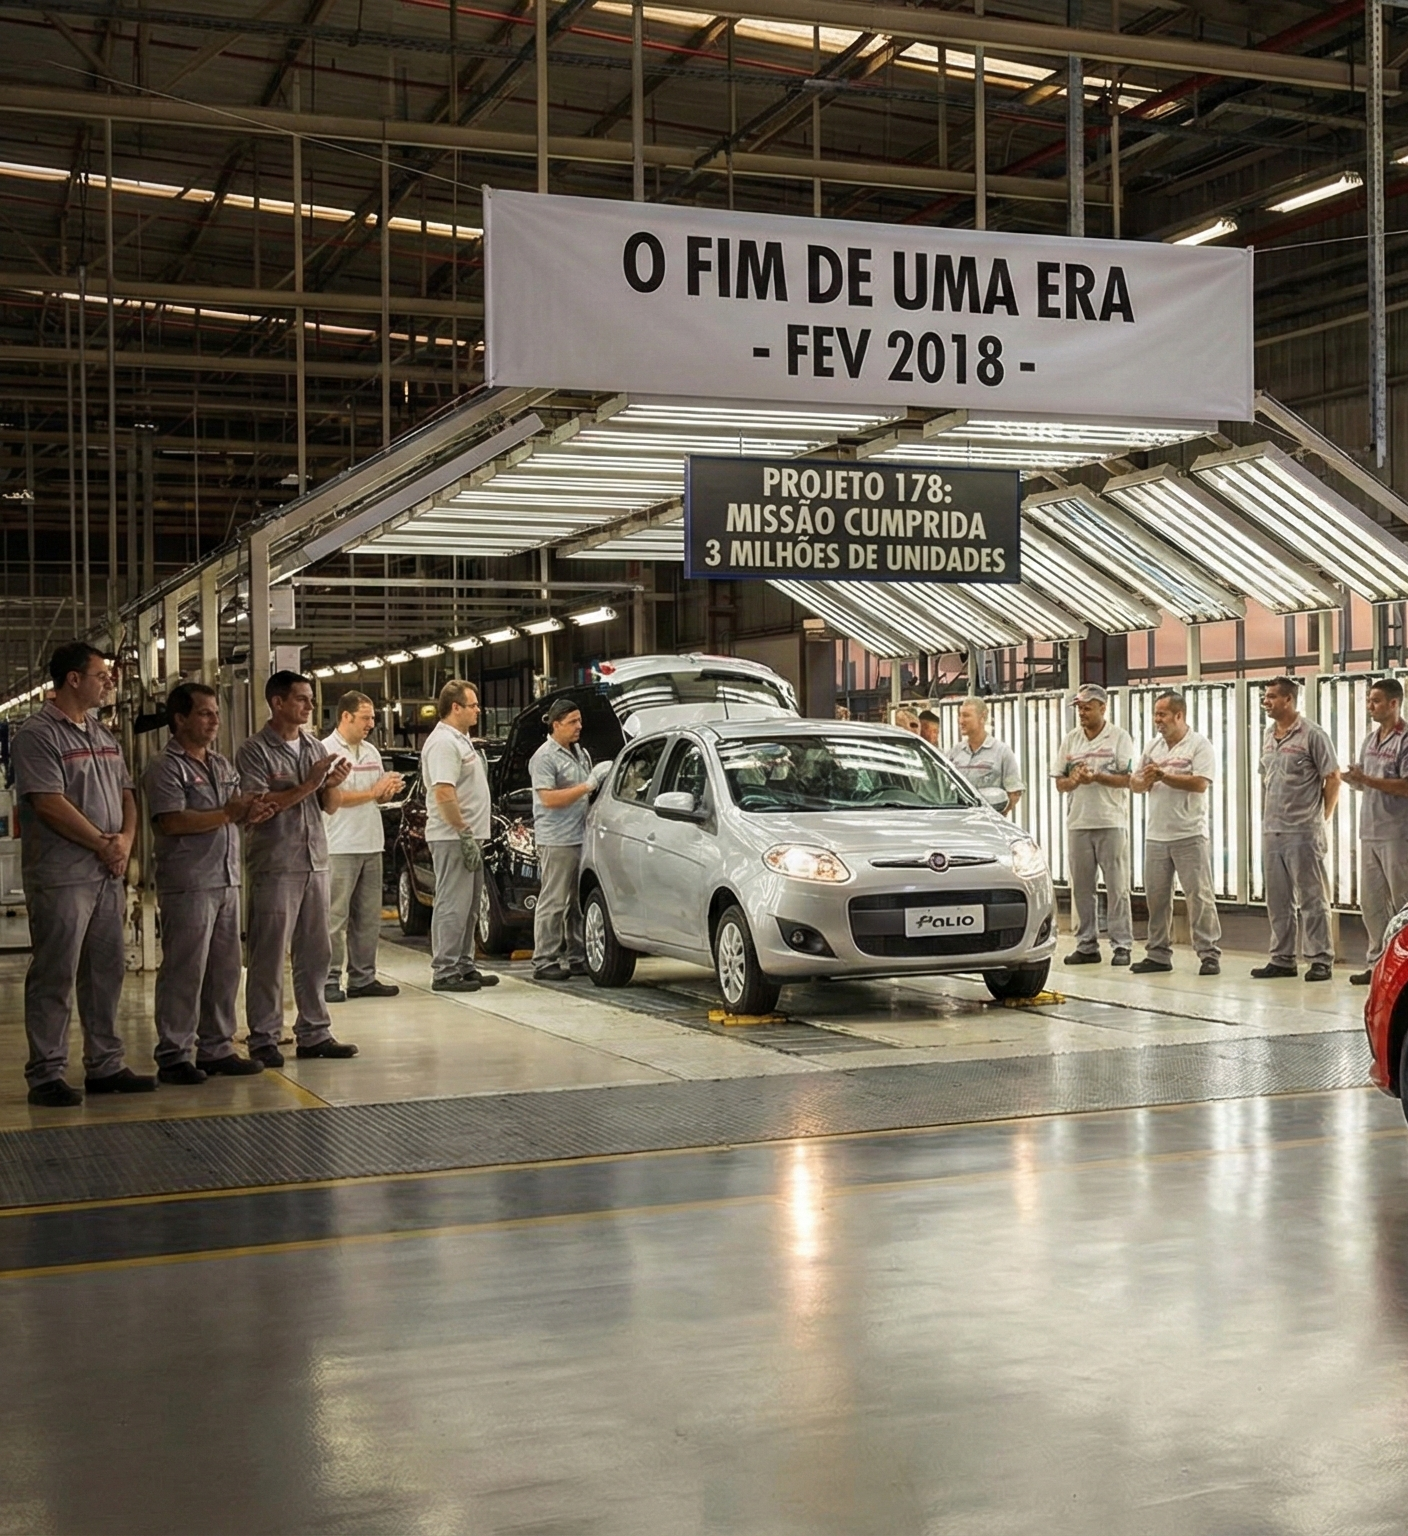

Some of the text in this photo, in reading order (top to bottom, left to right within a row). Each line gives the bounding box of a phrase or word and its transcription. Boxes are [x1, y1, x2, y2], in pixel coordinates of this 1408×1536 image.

[622, 231, 1135, 323] O FIM DE UMA ERA
[752, 323, 1036, 387] - FEV 2018 -
[763, 466, 952, 504] PROJETO 178:
[726, 498, 987, 540] MISSÃO CUMPRIDA
[704, 535, 1006, 573] 3 MILHÕES DE UNIDADES
